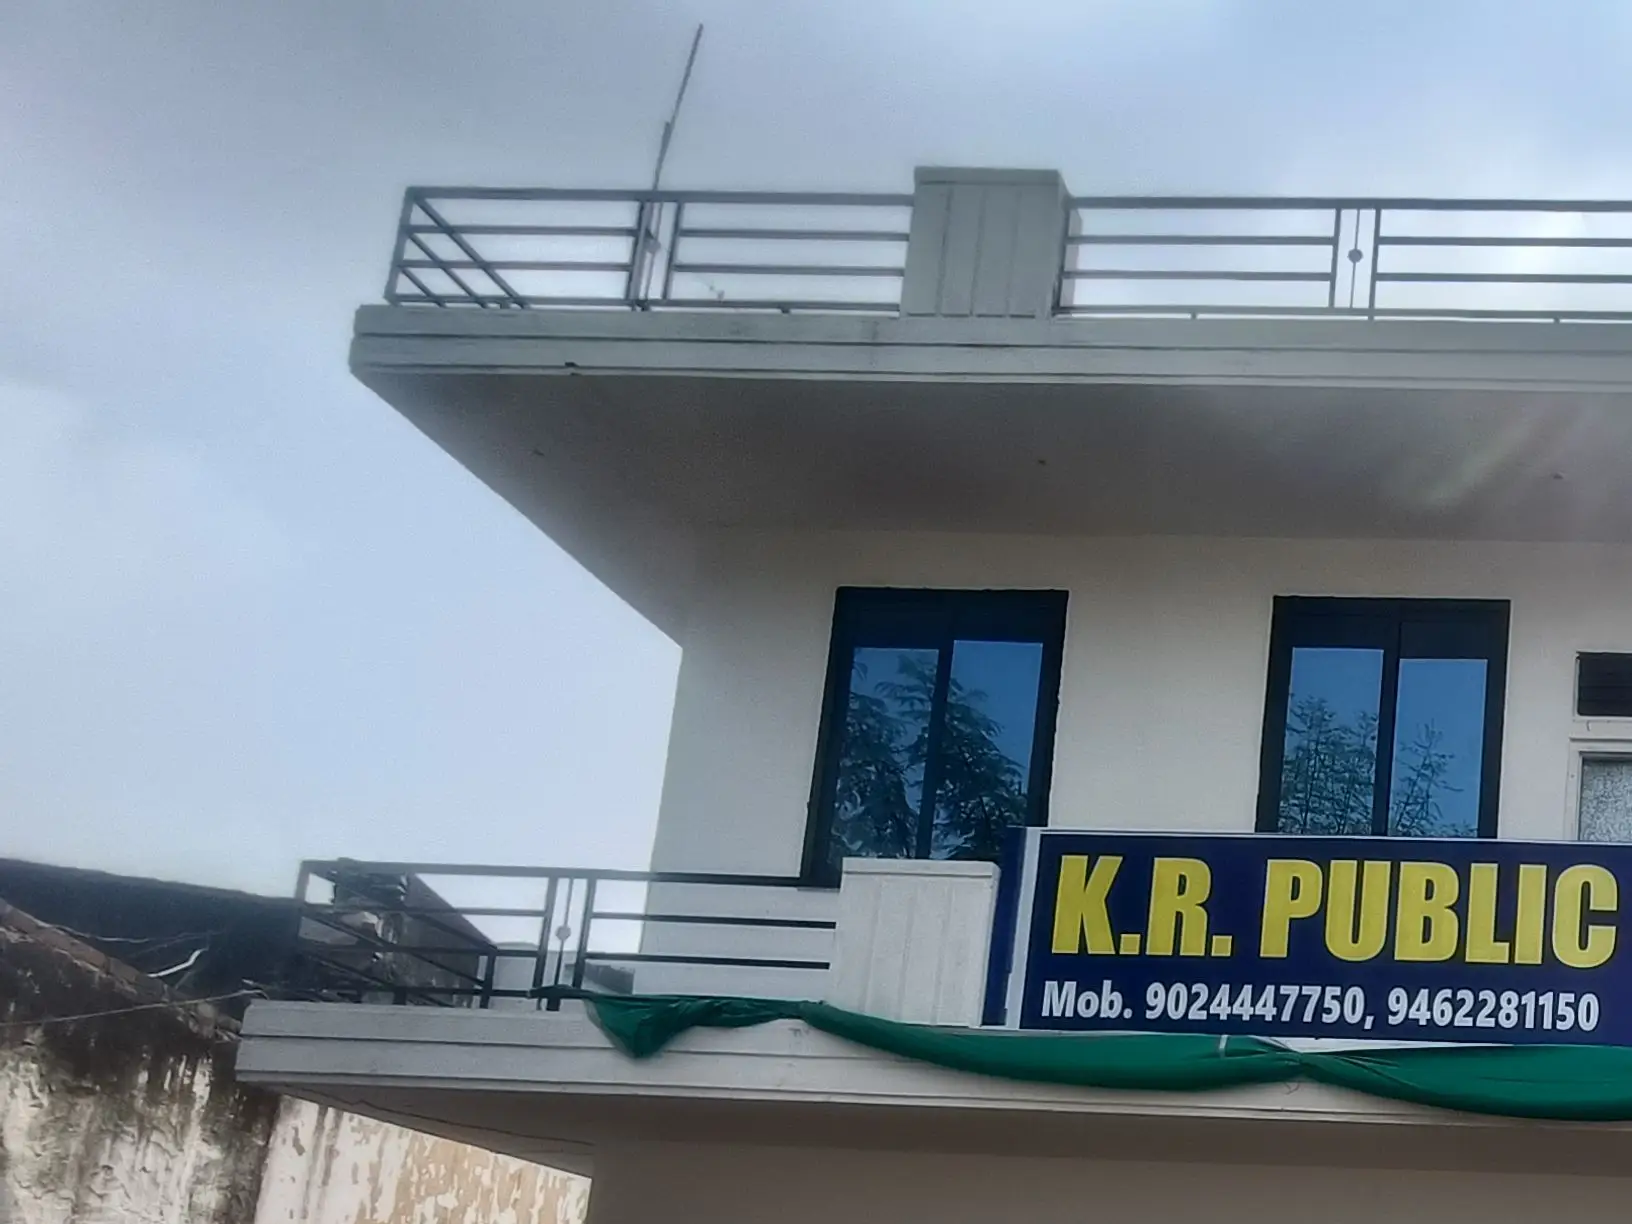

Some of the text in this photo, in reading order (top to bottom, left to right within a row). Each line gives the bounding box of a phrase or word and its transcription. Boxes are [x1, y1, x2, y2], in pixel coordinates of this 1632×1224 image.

[1051, 854, 1232, 957] K.R.
[1260, 859, 1619, 968] PUBLIC
[1041, 980, 1600, 1033] Mob. 9024447750, 9462281150
